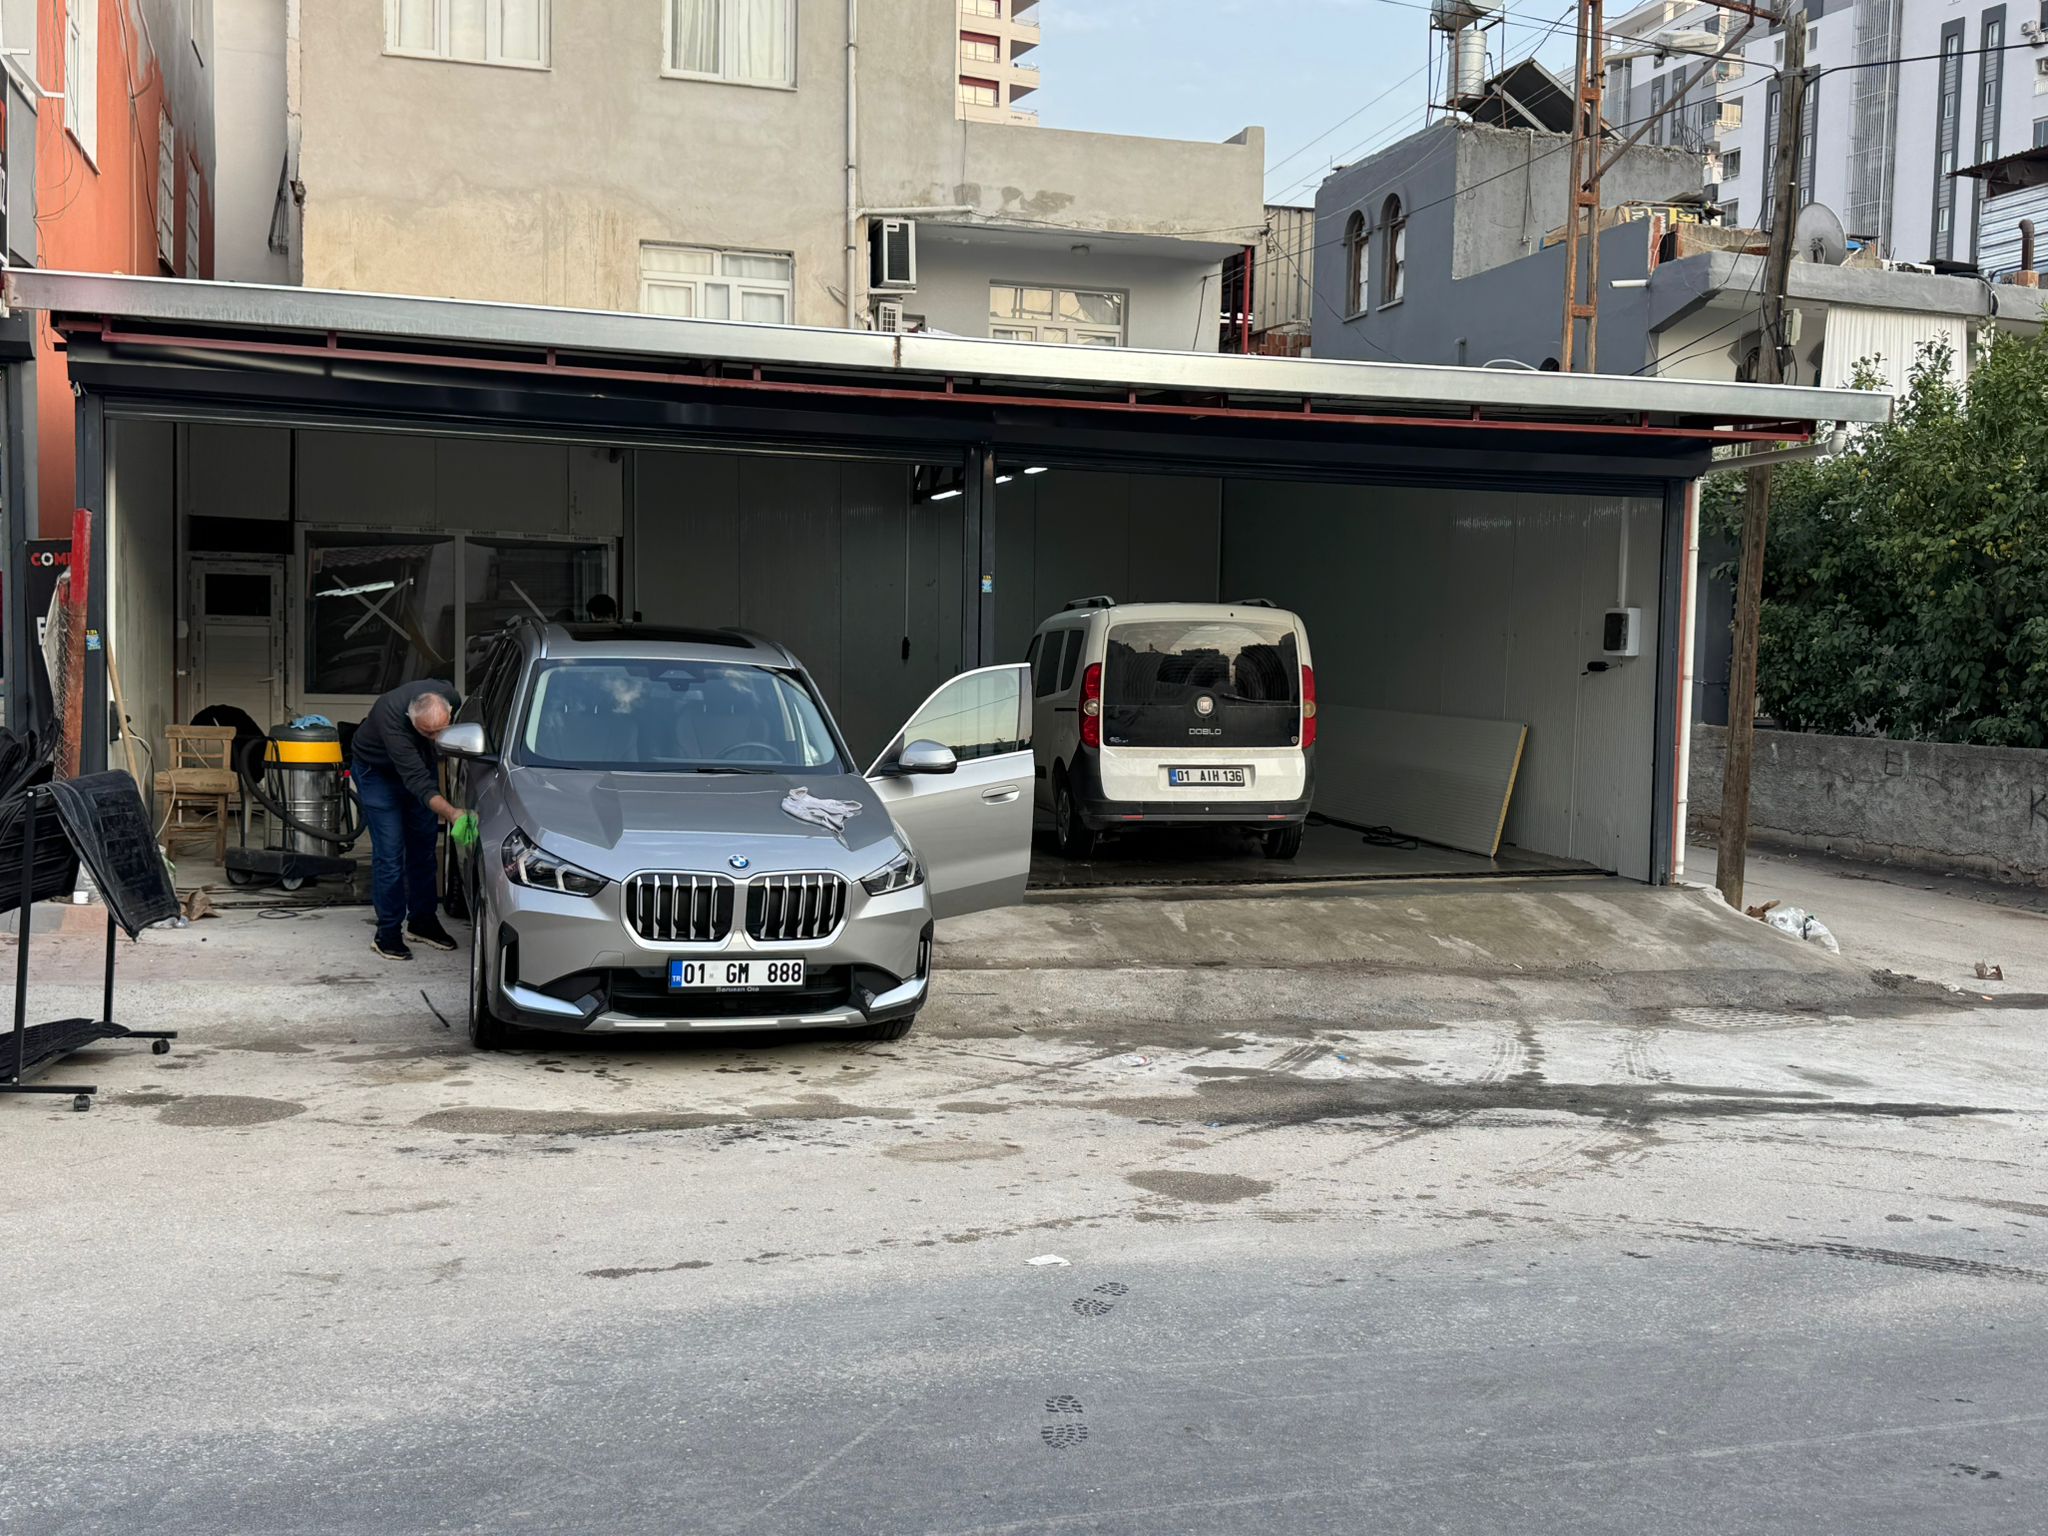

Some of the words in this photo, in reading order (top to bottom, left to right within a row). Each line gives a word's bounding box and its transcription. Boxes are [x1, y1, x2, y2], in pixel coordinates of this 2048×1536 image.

[31, 552, 71, 567] COM
[1177, 770, 1190, 782] 01
[1200, 770, 1219, 782] AIH
[1223, 770, 1242, 782] 136
[684, 963, 705, 984] 01
[726, 963, 749, 984] GM
[767, 962, 802, 983] 888
